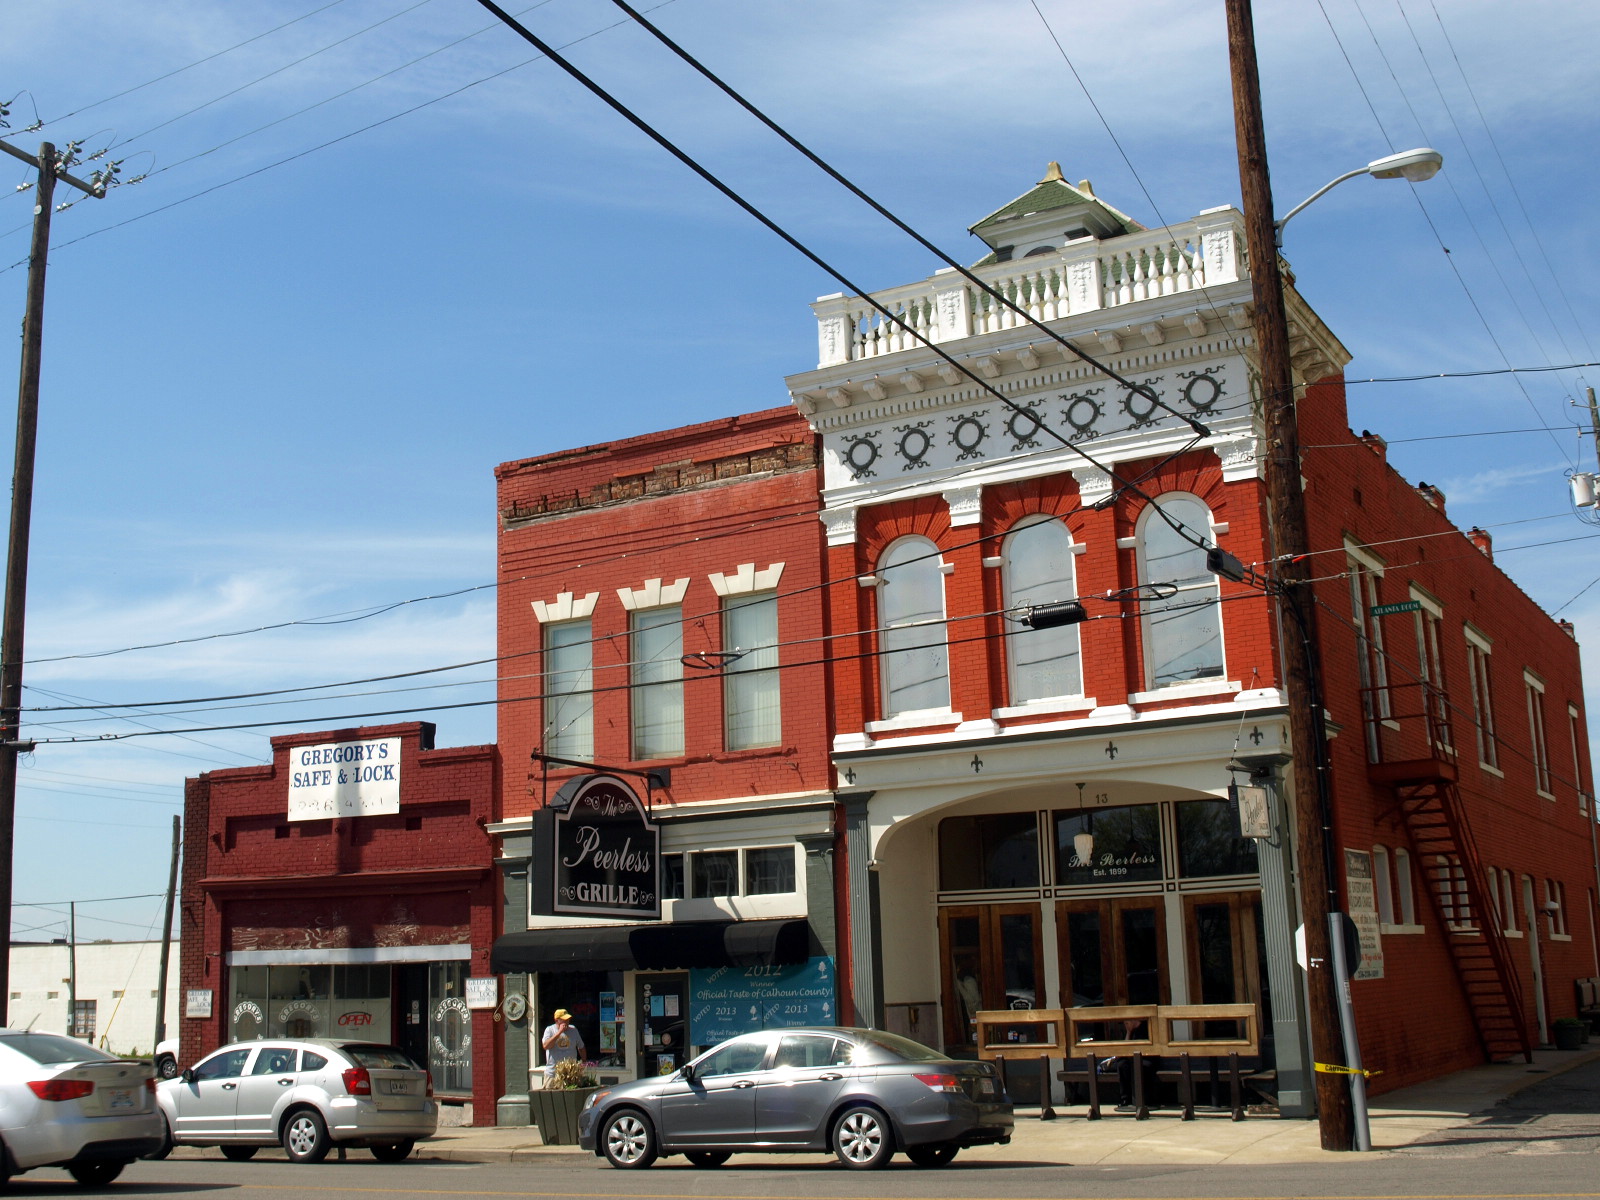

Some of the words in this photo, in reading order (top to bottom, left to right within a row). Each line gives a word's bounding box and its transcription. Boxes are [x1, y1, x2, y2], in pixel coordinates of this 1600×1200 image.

[301, 743, 388, 766] GREGORY'S
[293, 770, 331, 788] SAFE
[337, 768, 348, 785] &
[354, 764, 395, 783] LOCK
[601, 794, 618, 817] The
[1095, 793, 1109, 804] 13
[562, 825, 650, 873] Peerless
[1099, 852, 1155, 867] Peerless
[1093, 869, 1107, 877] Est.
[1109, 867, 1127, 876] 1899
[576, 882, 639, 905] GRILLE
[706, 965, 729, 984] VOTED
[744, 964, 783, 977] 2012
[750, 980, 775, 988] Winner
[696, 989, 727, 999] Official
[728, 990, 750, 998] Taste
[751, 990, 760, 999] of
[761, 988, 799, 998] Calhoun
[799, 987, 833, 998] County!
[233, 1001, 263, 1023] GREGORY'S
[279, 1000, 321, 1022] GREGORY'S
[693, 1004, 711, 1023] VOTED
[715, 1006, 737, 1015] 2013
[784, 1004, 808, 1014] 2013
[338, 1014, 372, 1026] OPEN
[1324, 1064, 1349, 1073] CAUTION
